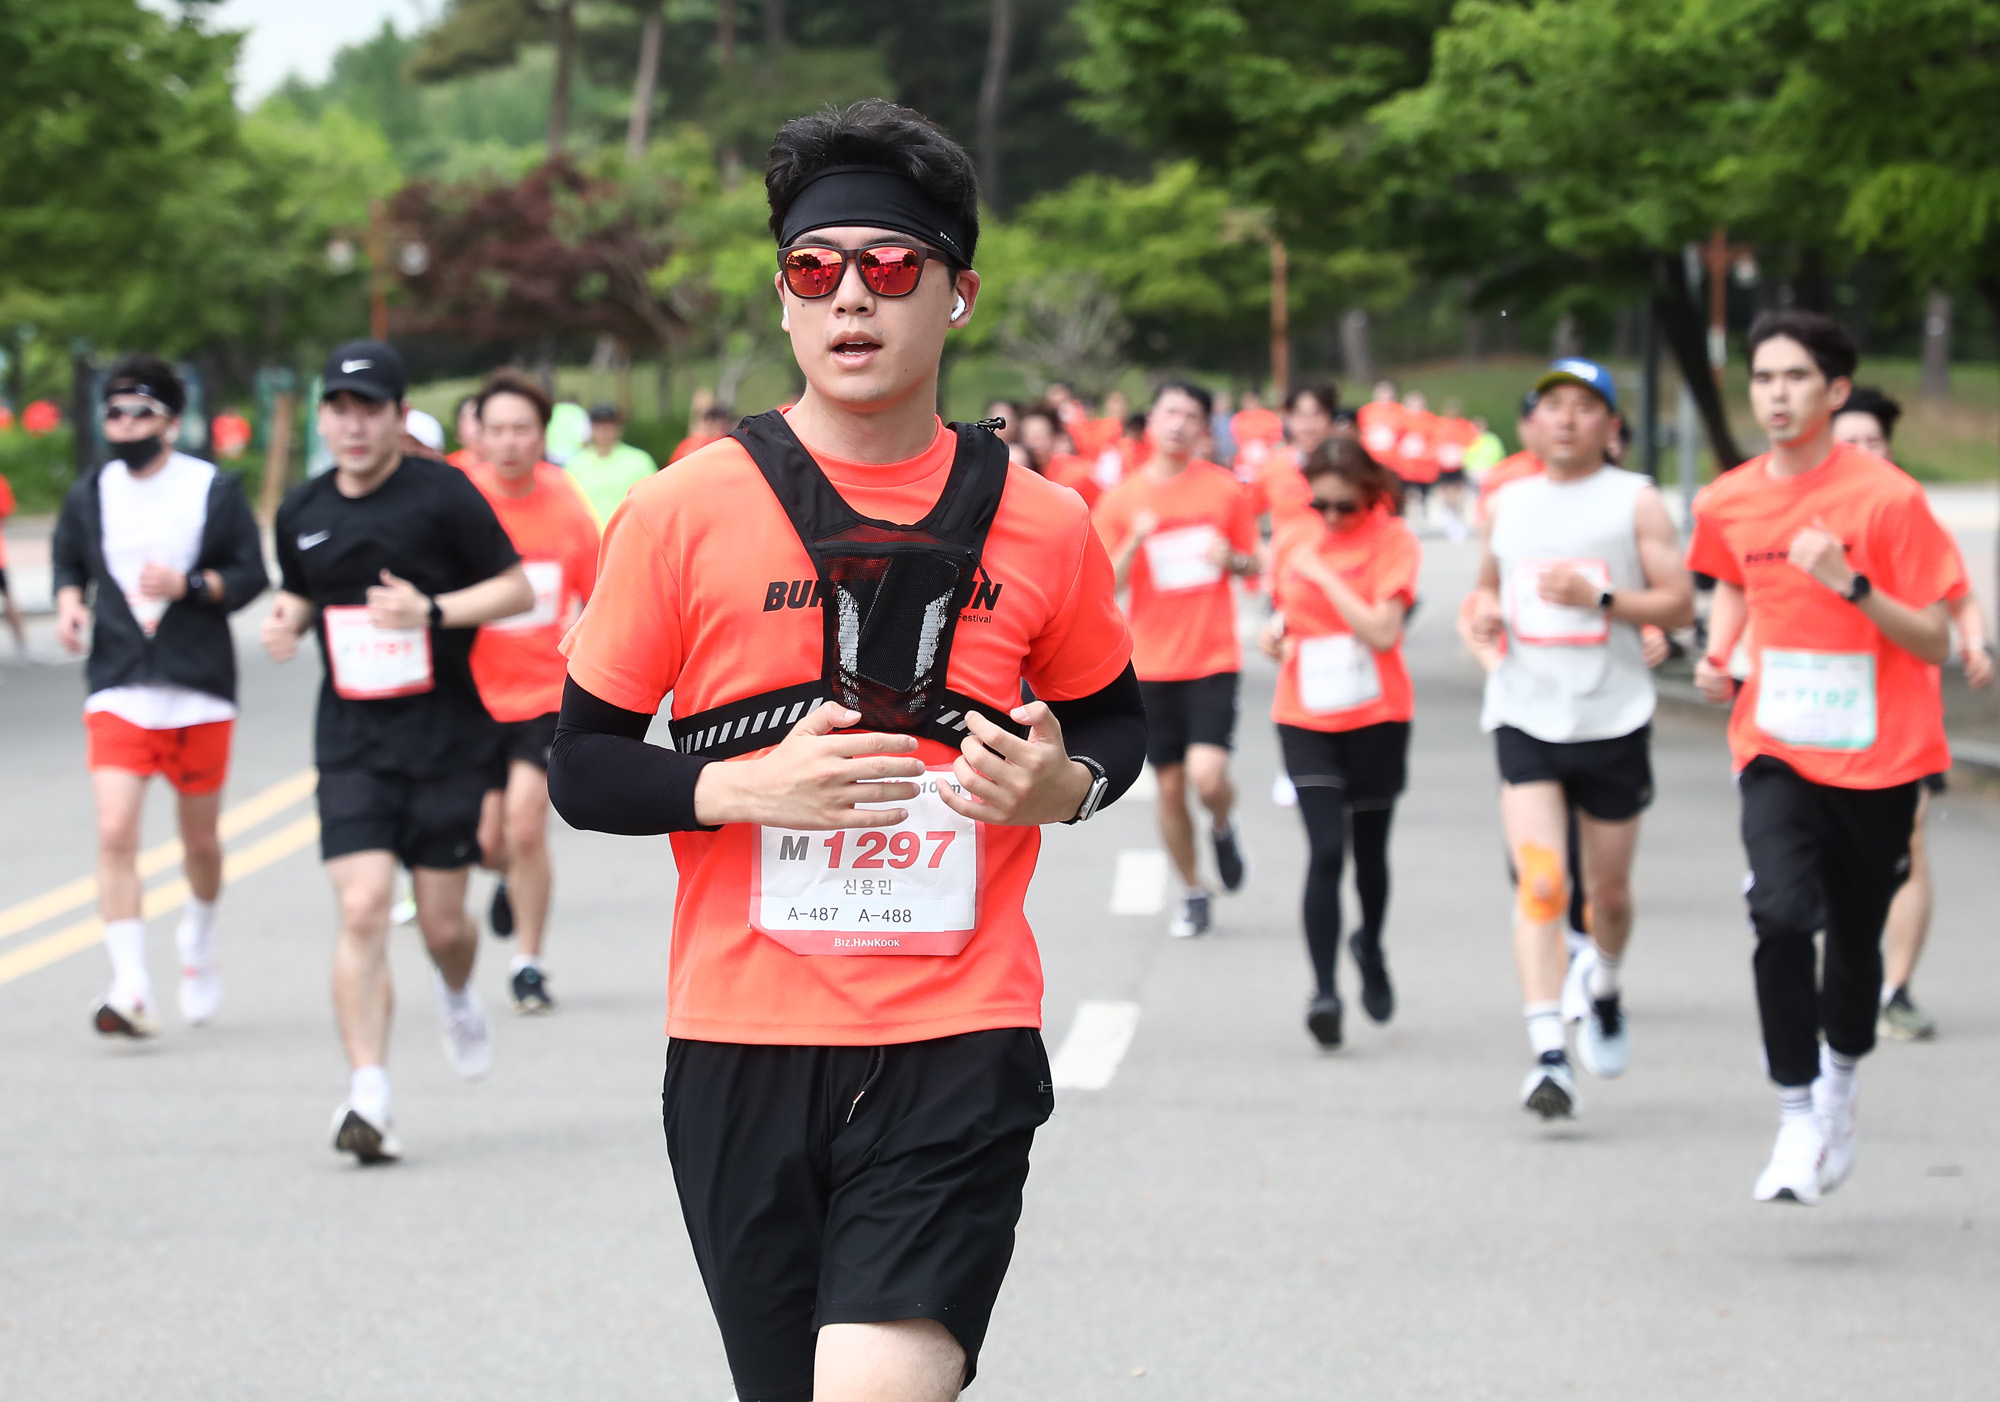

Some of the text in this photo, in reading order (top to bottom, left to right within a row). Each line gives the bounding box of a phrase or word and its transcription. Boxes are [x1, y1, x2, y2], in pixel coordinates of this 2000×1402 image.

[779, 831, 956, 869] M 1297
[843, 879, 892, 896] 신용민
[787, 907, 912, 923] A-487 A-488
